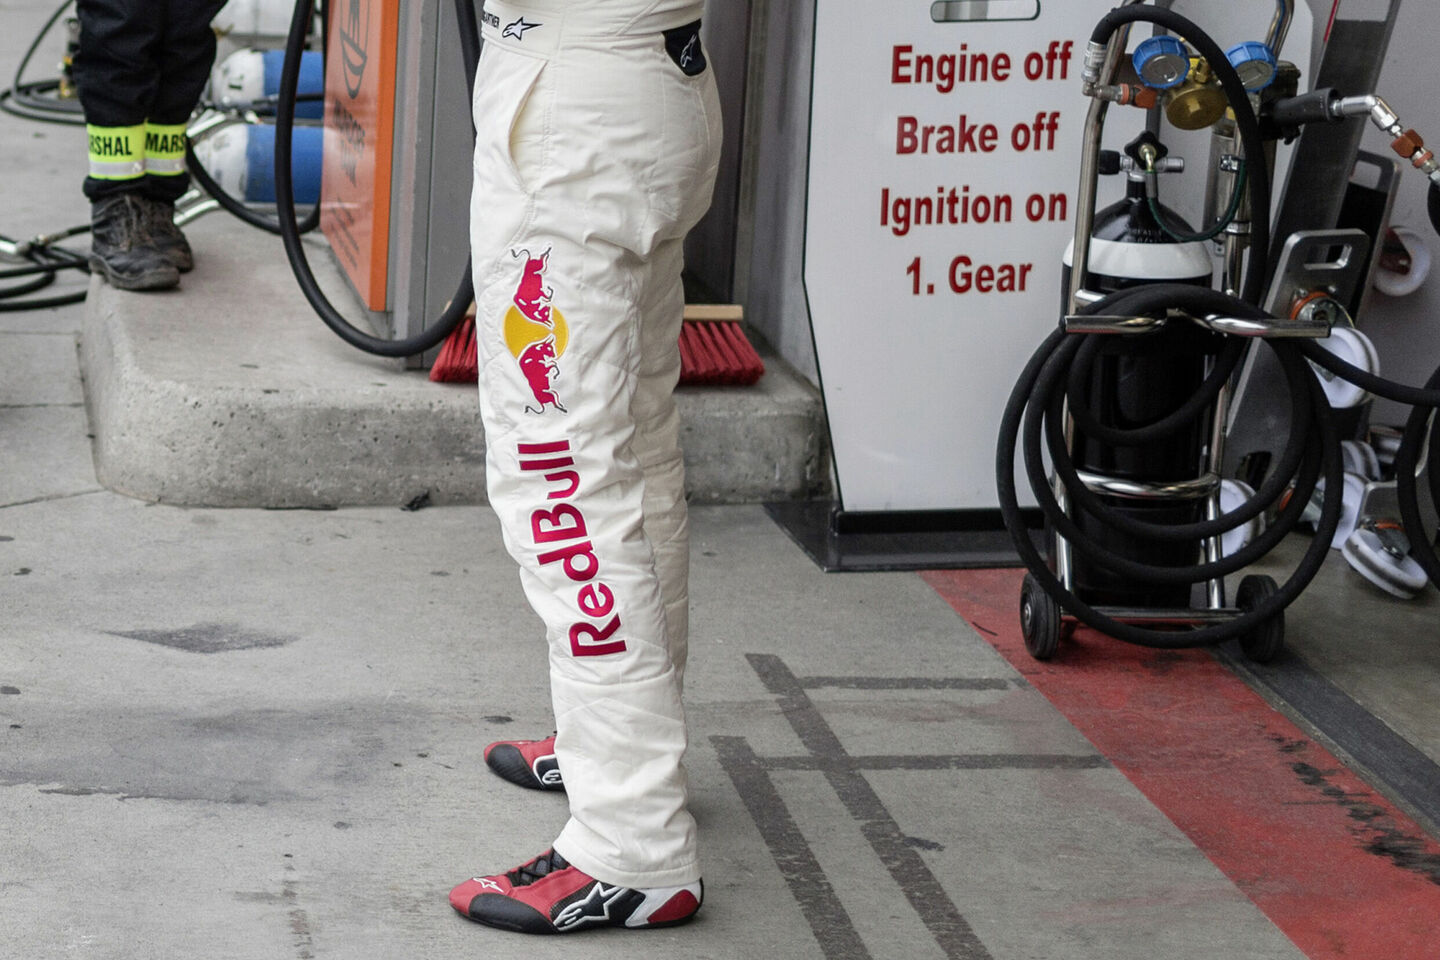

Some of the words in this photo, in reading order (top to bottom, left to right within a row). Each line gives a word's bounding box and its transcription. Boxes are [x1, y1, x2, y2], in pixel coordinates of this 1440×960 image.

[891, 43, 1011, 93] Engine
[1023, 40, 1074, 81] off
[896, 114, 999, 155] Brake
[1010, 111, 1060, 152] off
[880, 185, 1012, 236] Ignition
[1025, 192, 1068, 222] on
[906, 256, 935, 296] 1.
[948, 254, 1033, 294] Gear
